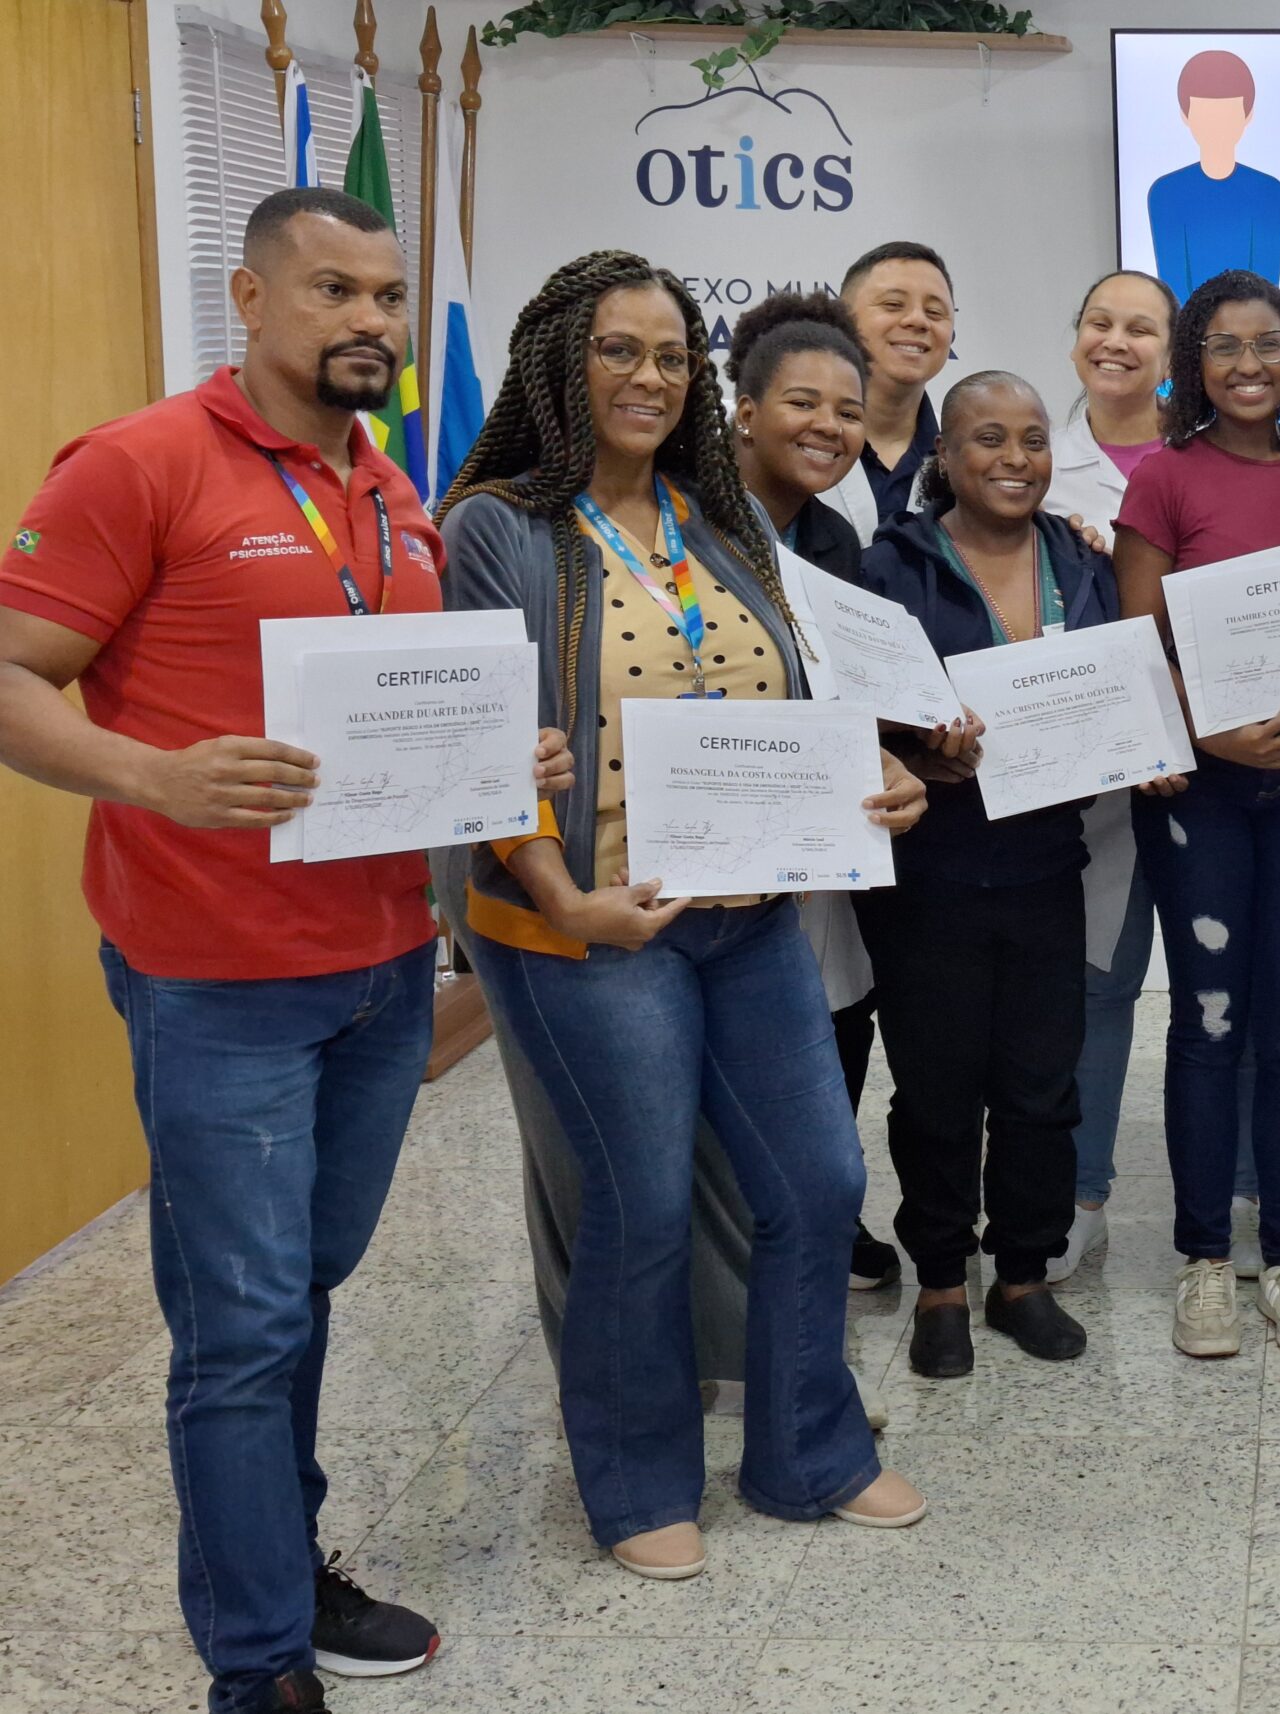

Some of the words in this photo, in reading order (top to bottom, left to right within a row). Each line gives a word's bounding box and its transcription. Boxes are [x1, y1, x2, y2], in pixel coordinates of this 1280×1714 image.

[636, 135, 854, 212] otics
[242, 532, 295, 548] ATENÇÃO
[229, 545, 312, 560] PSICOSSOCIAL
[1225, 610, 1267, 625] THAMIRES
[377, 667, 481, 687] CERTIFICADO
[1012, 663, 1097, 690] CERTIFICADO
[346, 708, 413, 724] ALEXANDER
[417, 706, 459, 719] DUARTE
[461, 705, 474, 715] DA
[476, 702, 504, 714] SILVA
[994, 708, 1012, 718] ANA
[1052, 695, 1075, 706] LIMA
[1075, 692, 1086, 700] DE
[700, 736, 800, 753] CERTIFICADO
[671, 767, 725, 777] ROSANGELA
[727, 770, 740, 778] DA
[742, 770, 772, 779] COSTA
[774, 770, 829, 781] CONCEIÇÃO
[1108, 771, 1126, 784] RIO
[463, 820, 484, 835] RIO
[787, 872, 808, 882] RIO
